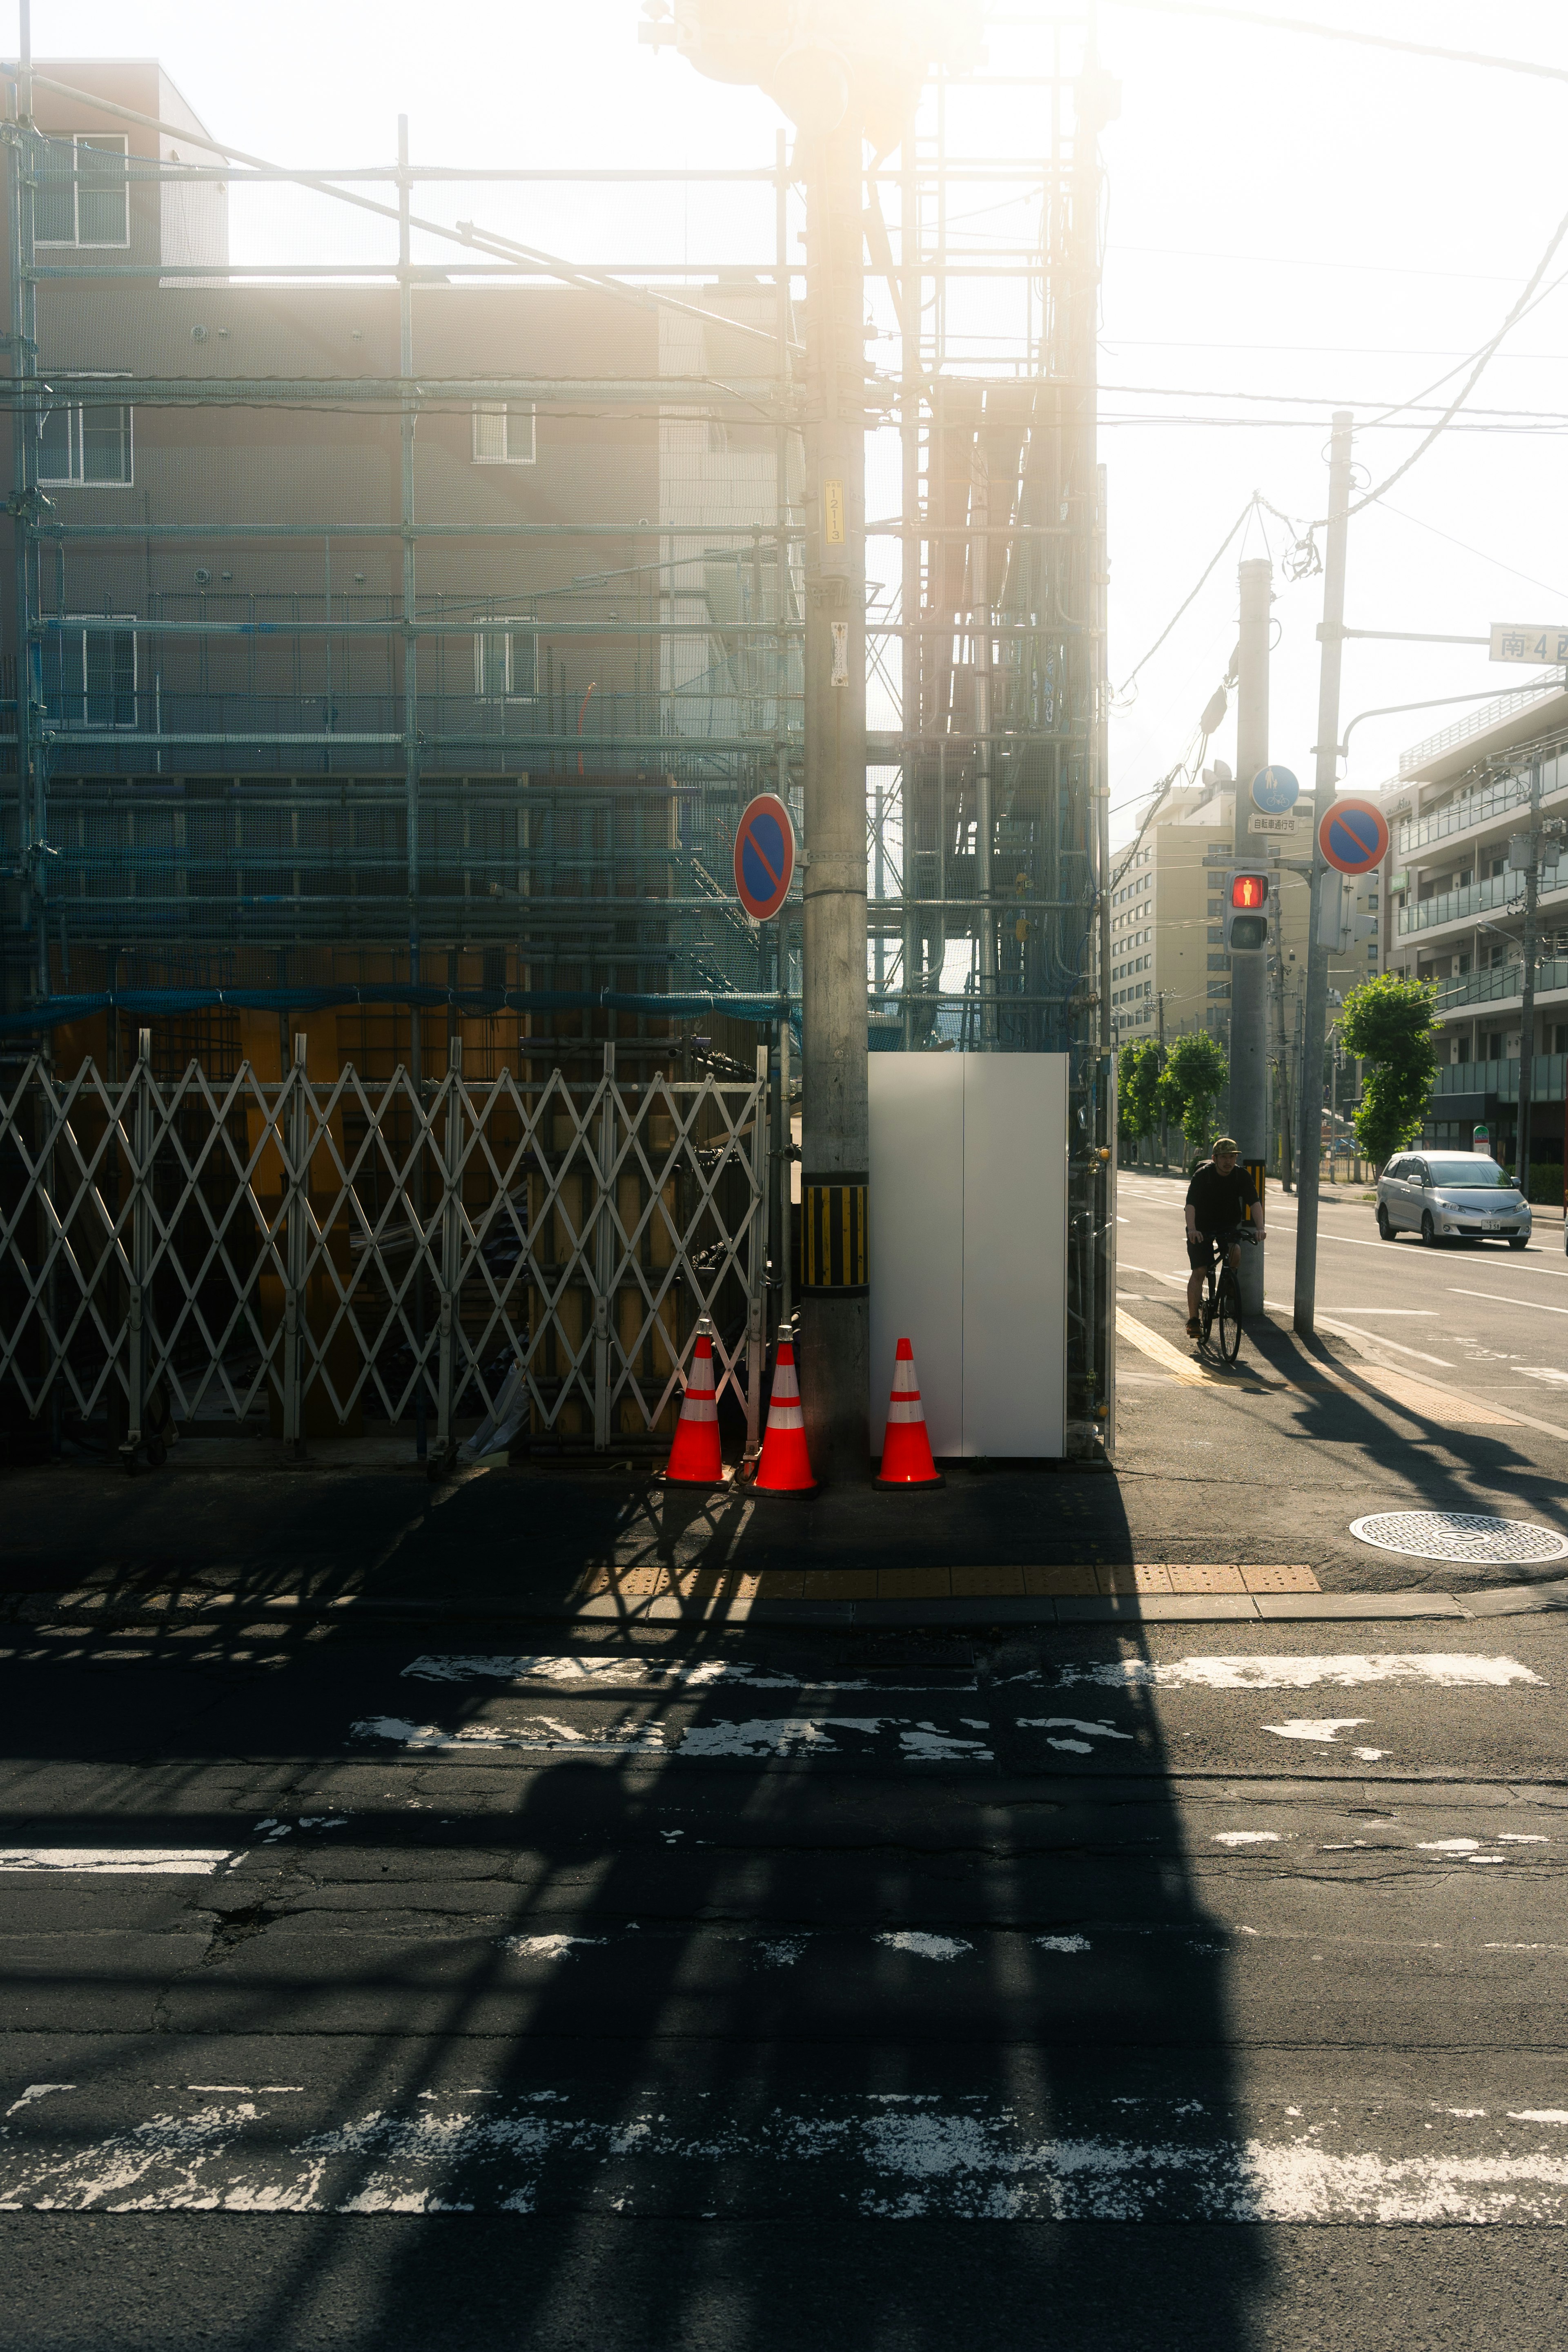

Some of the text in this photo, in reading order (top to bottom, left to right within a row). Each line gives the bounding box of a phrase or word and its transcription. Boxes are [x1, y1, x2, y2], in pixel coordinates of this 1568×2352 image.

[831, 489, 839, 540] 12113
[1255, 818, 1294, 830] 自転車通行可
